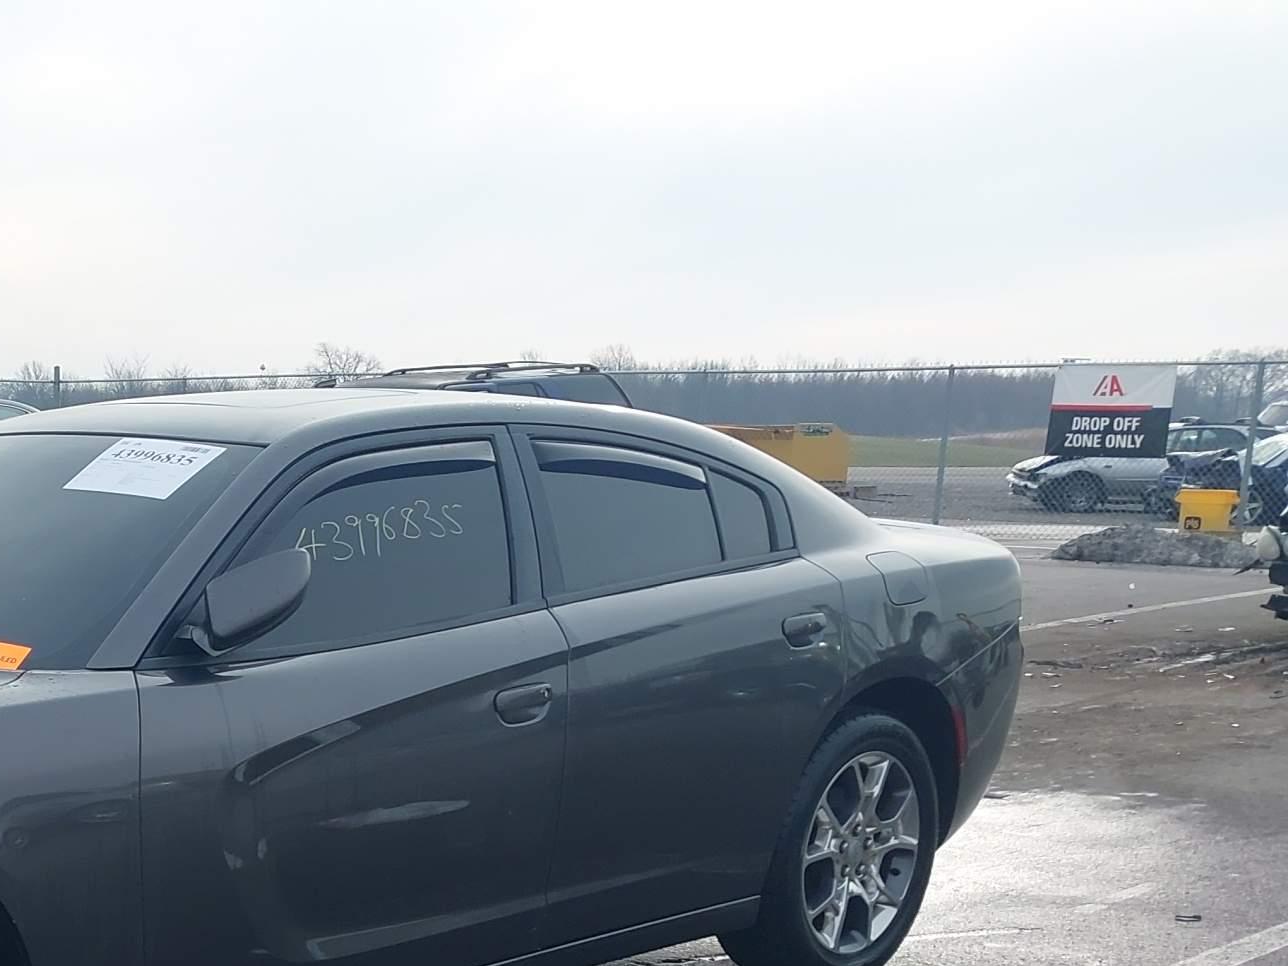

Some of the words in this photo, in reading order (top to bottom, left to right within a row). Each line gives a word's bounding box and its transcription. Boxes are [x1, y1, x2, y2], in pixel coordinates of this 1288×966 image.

[1072, 416, 1109, 431] DROP
[1113, 417, 1141, 431] OFF
[1064, 433, 1102, 448] ZONE
[1105, 434, 1144, 448] ONLY
[112, 448, 198, 466] 43996835
[295, 500, 463, 561] 43996835
